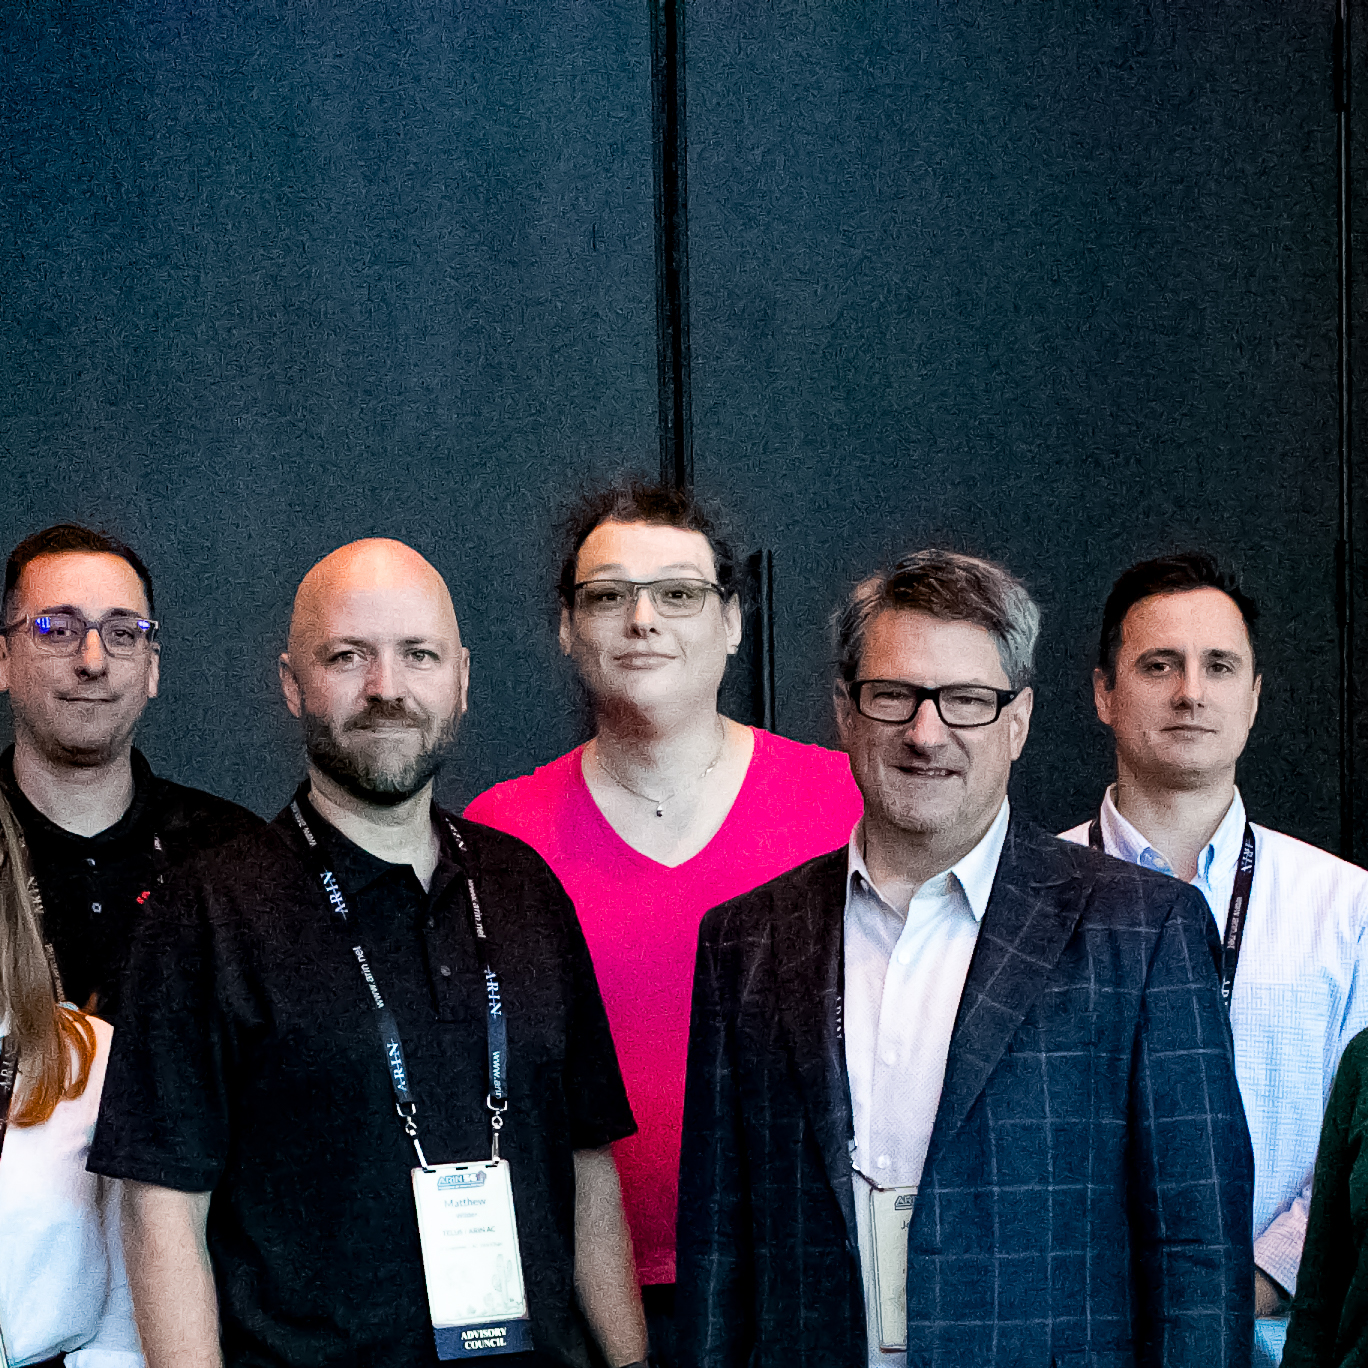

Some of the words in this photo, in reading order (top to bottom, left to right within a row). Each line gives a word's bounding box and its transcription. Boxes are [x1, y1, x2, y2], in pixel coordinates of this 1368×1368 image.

[484, 965, 503, 1019] ARIN
[386, 1038, 410, 1098] ARIN
[444, 1197, 487, 1208] Matthew
[461, 1327, 507, 1341] ADVISORY
[464, 1338, 507, 1350] COUNCIL
